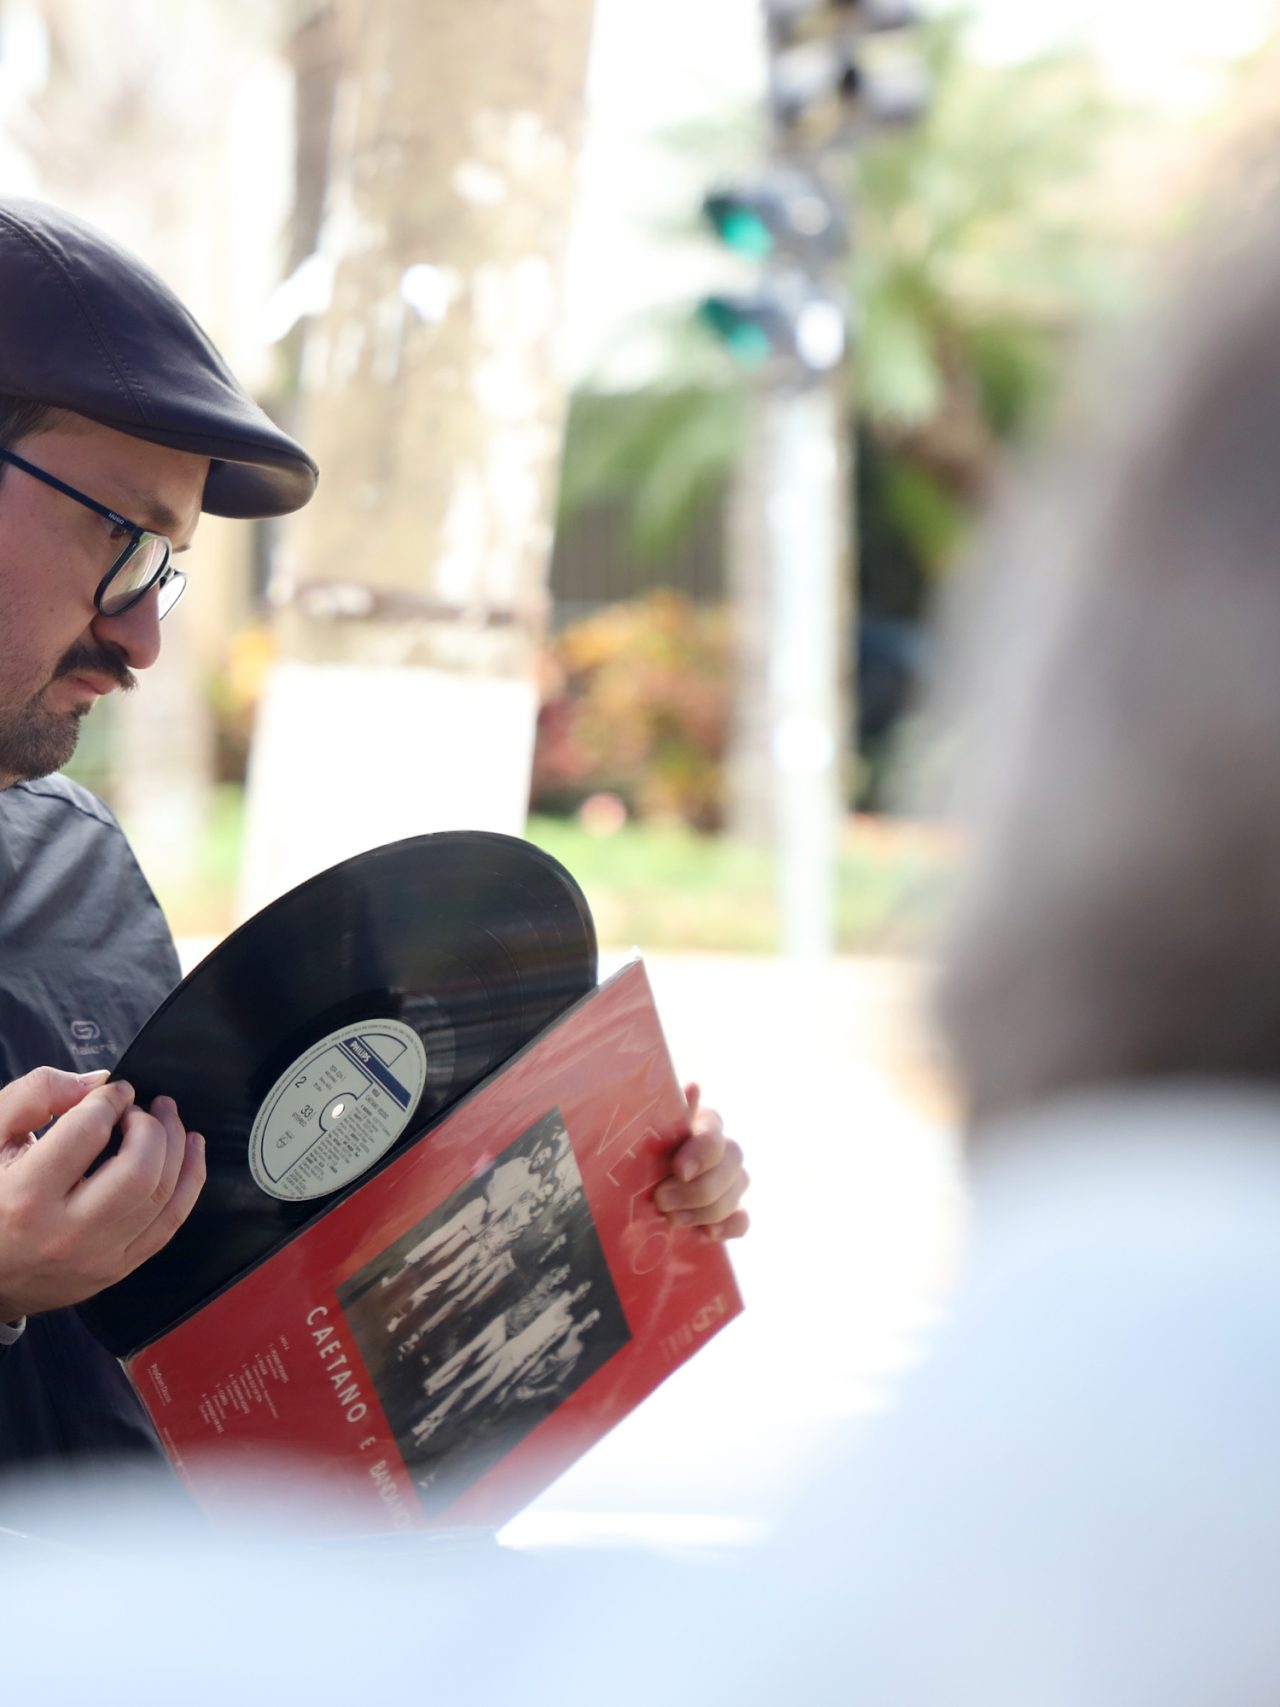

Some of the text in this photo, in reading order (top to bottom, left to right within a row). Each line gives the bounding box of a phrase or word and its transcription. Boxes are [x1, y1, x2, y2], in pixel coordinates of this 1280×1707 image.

[350, 1040, 372, 1063] PHILIPS
[294, 1076, 308, 1089] 2
[306, 1305, 368, 1423] CAETANO
[359, 1436, 377, 1451] E
